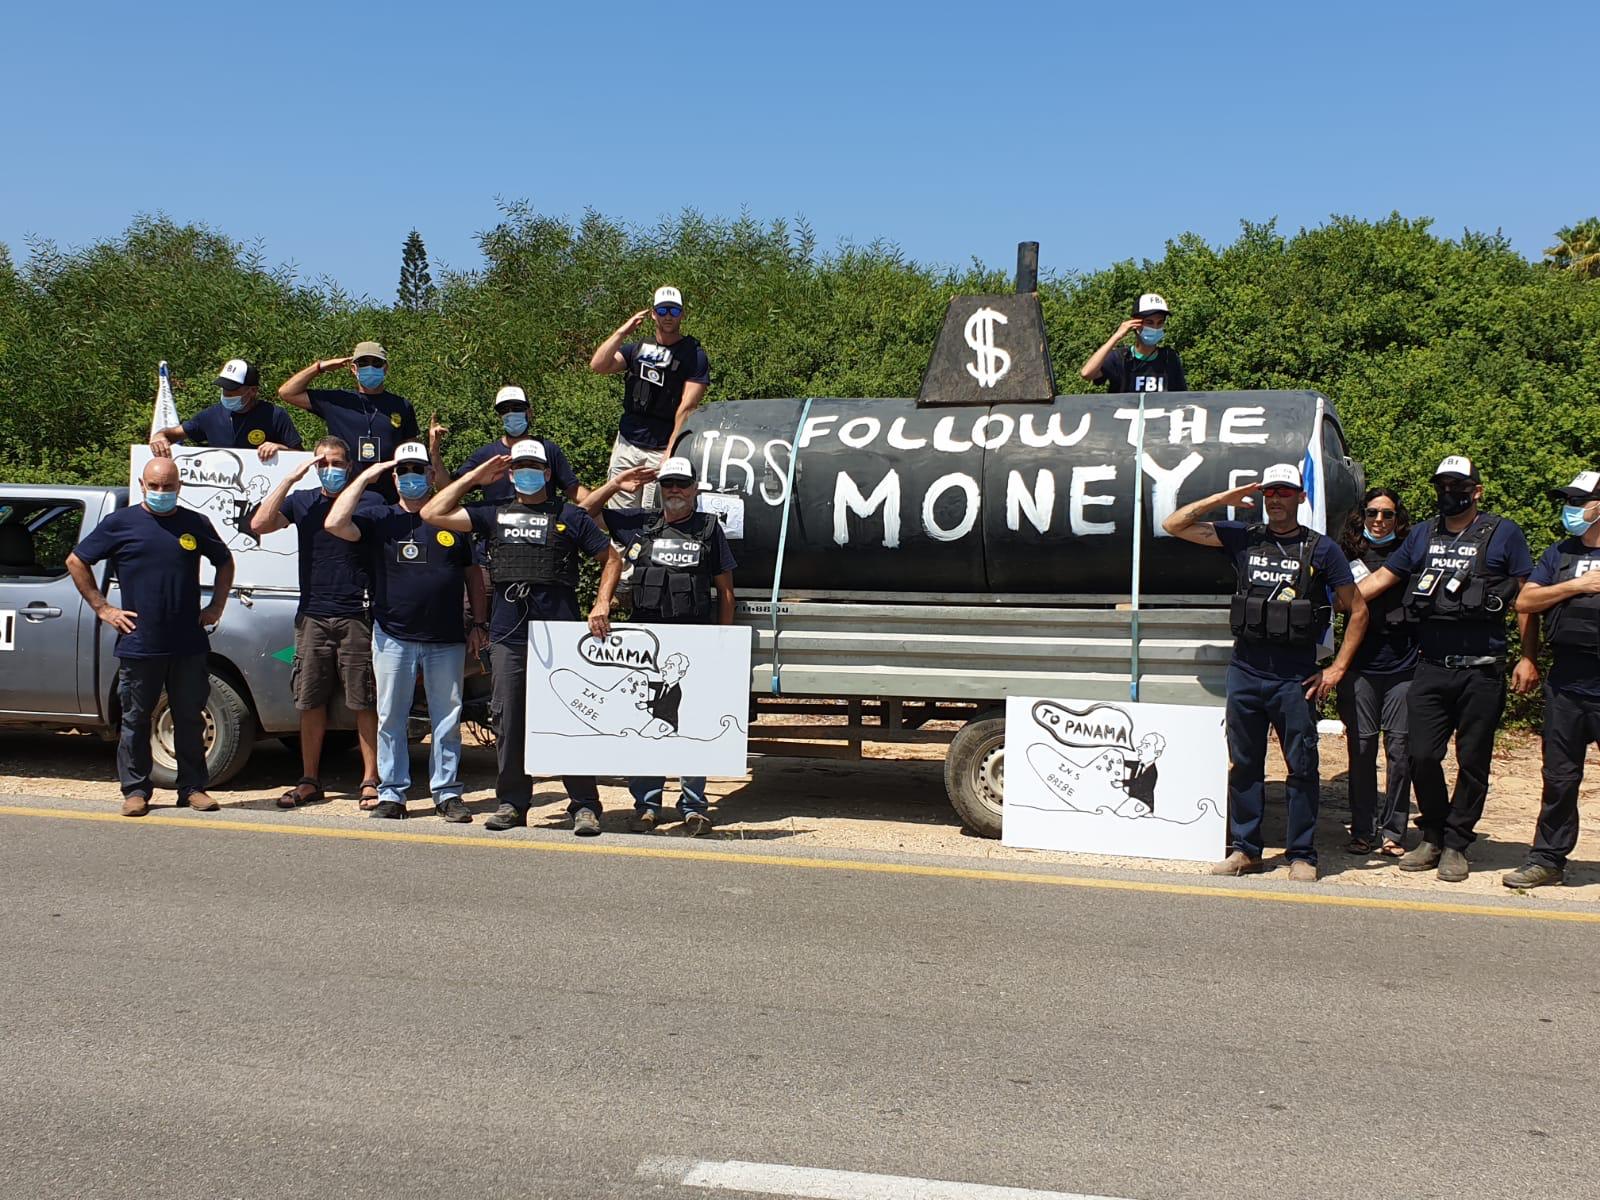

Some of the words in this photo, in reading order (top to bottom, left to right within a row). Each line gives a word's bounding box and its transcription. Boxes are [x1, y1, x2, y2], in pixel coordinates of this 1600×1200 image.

[1149, 296, 1163, 305] FBI
[1135, 375, 1164, 392] FBI
[799, 412, 1091, 452] FOLLOW
[1113, 404, 1270, 447] THE
[402, 444, 419, 454] FBI
[180, 468, 242, 485] PANAMA
[697, 430, 790, 506] IRS
[833, 451, 1203, 548] MONEY
[529, 517, 549, 526] CID
[504, 528, 541, 538] POLICE
[682, 542, 700, 551] CID
[1429, 545, 1446, 554] IRS
[1457, 546, 1477, 556] CID
[658, 553, 693, 563] POLICE
[1249, 555, 1268, 567] IRS
[1280, 560, 1300, 570] CID
[588, 645, 653, 664] PANAMA
[570, 699, 599, 720] BRIBE
[1042, 708, 1060, 725] TO
[1065, 720, 1127, 743] PANAMA
[1047, 774, 1075, 797] BRIBE
